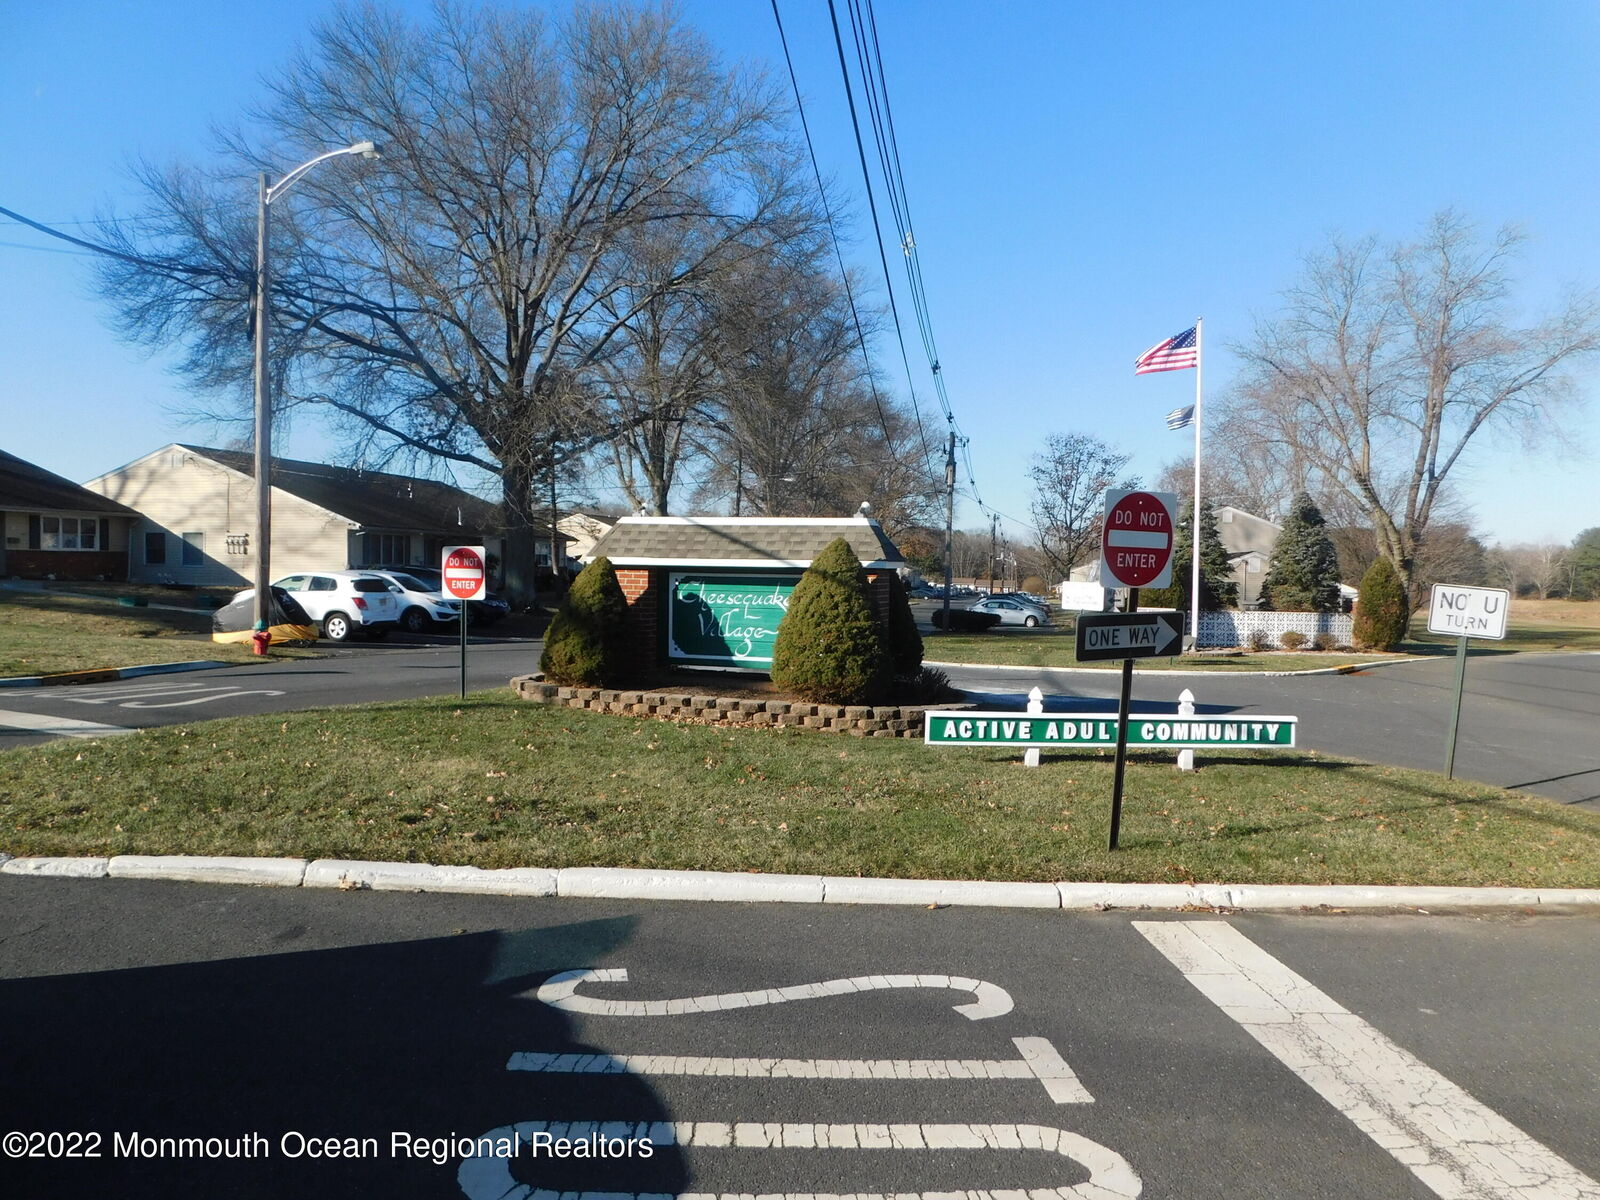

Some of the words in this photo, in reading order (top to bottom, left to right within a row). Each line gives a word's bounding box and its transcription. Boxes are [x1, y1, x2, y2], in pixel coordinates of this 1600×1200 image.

[1115, 510, 1132, 525] DO
[1139, 511, 1165, 527] NOT
[449, 557, 459, 566] DO
[463, 557, 478, 566] NOT
[1116, 552, 1156, 568] ENTER
[451, 580, 476, 589] ENTER
[1439, 592, 1467, 611] NO
[1483, 596, 1499, 614] U
[1446, 614, 1488, 630] TURN
[698, 608, 779, 657] Village
[1088, 628, 1120, 647] ONE
[1128, 626, 1160, 644] WAY
[943, 720, 1031, 739] ACTIVE
[1045, 721, 1118, 740] ADUL
[1140, 722, 1280, 742] COMMUNITY
